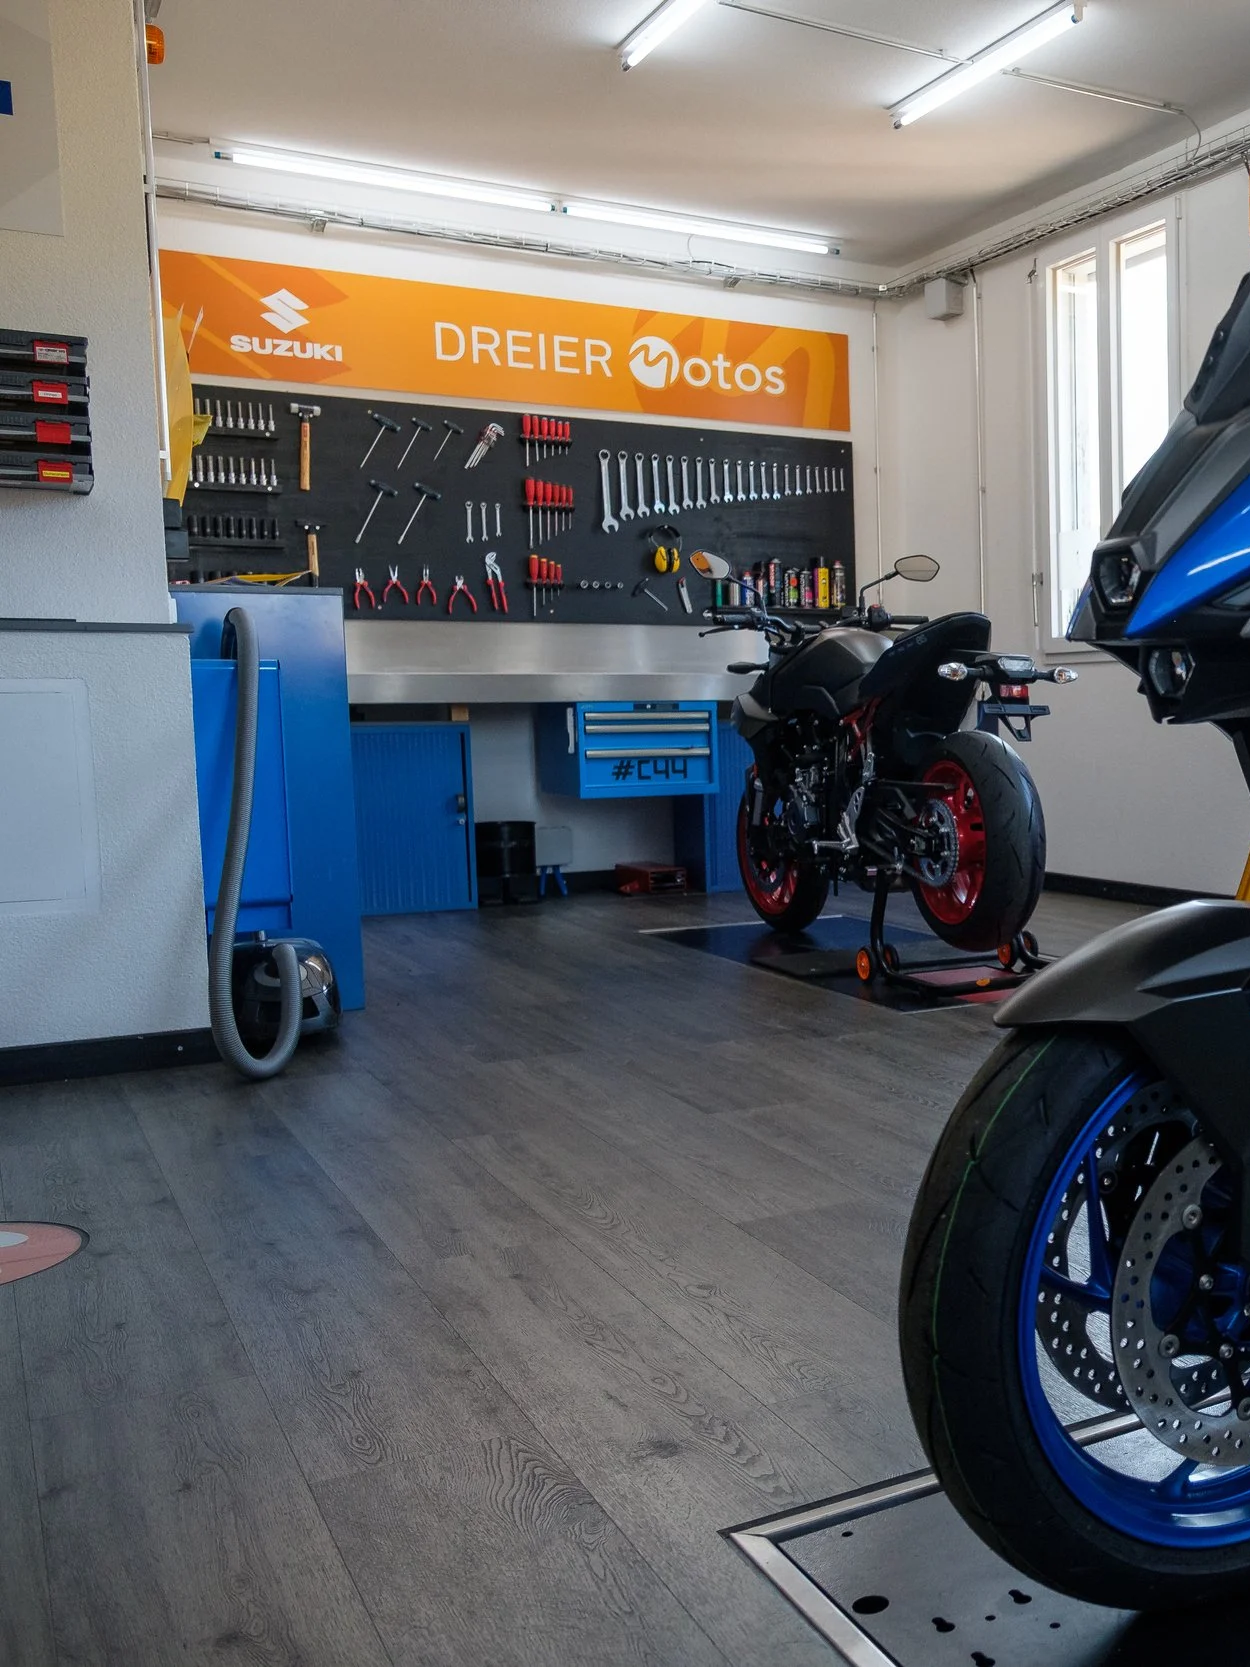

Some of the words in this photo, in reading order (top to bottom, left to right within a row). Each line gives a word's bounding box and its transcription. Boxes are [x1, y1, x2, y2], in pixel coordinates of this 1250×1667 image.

[230, 334, 343, 362] SUZUKI
[434, 321, 613, 378] DREIER
[611, 758, 688, 781] #C44
